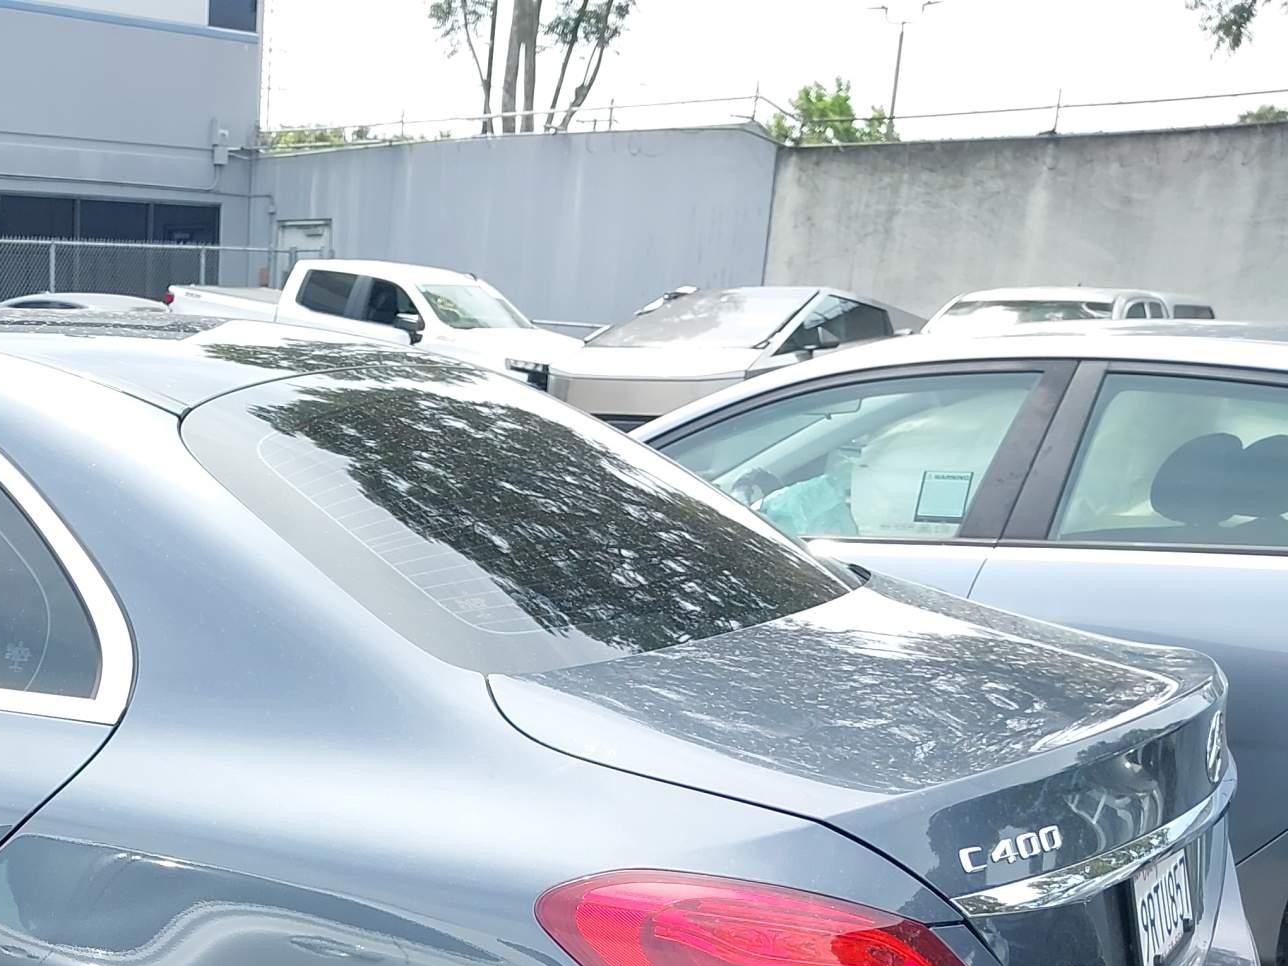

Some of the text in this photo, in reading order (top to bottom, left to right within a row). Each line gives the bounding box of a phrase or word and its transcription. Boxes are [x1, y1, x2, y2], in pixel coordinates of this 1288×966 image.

[959, 825, 1062, 873] C 400
[1140, 856, 1191, 962] 9RTU857
